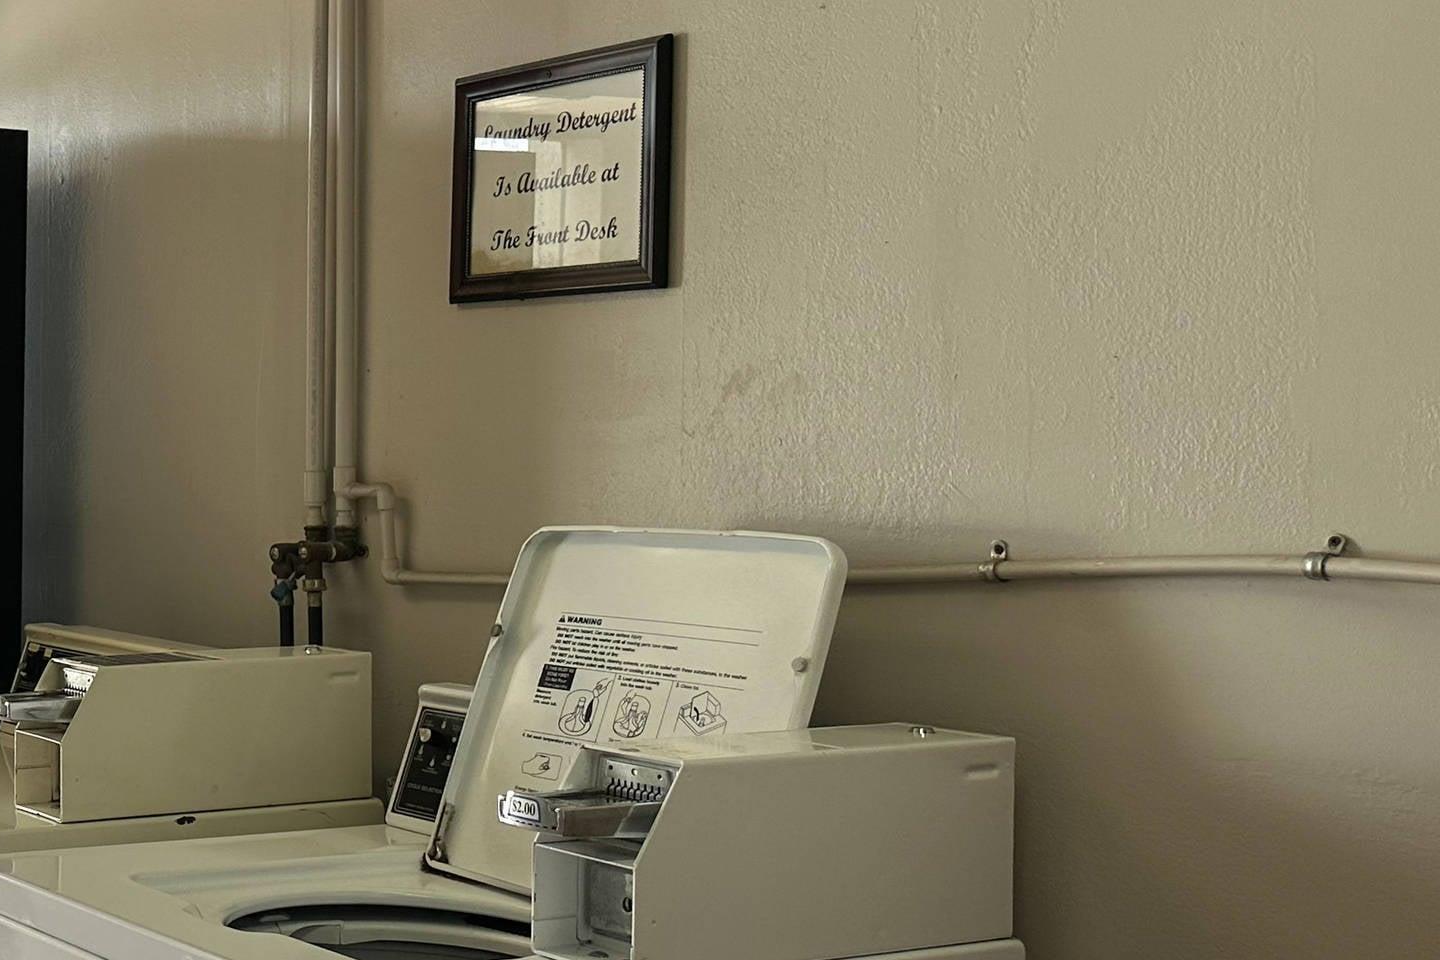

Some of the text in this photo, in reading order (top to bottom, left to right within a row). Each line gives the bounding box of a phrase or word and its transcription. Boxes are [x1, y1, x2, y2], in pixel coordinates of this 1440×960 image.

[484, 101, 636, 143] Laundry Detergent
[493, 162, 620, 198] Is Available at
[490, 216, 618, 251] The Front Desk
[566, 615, 603, 626] WARNING
[512, 800, 536, 817] $2.00
